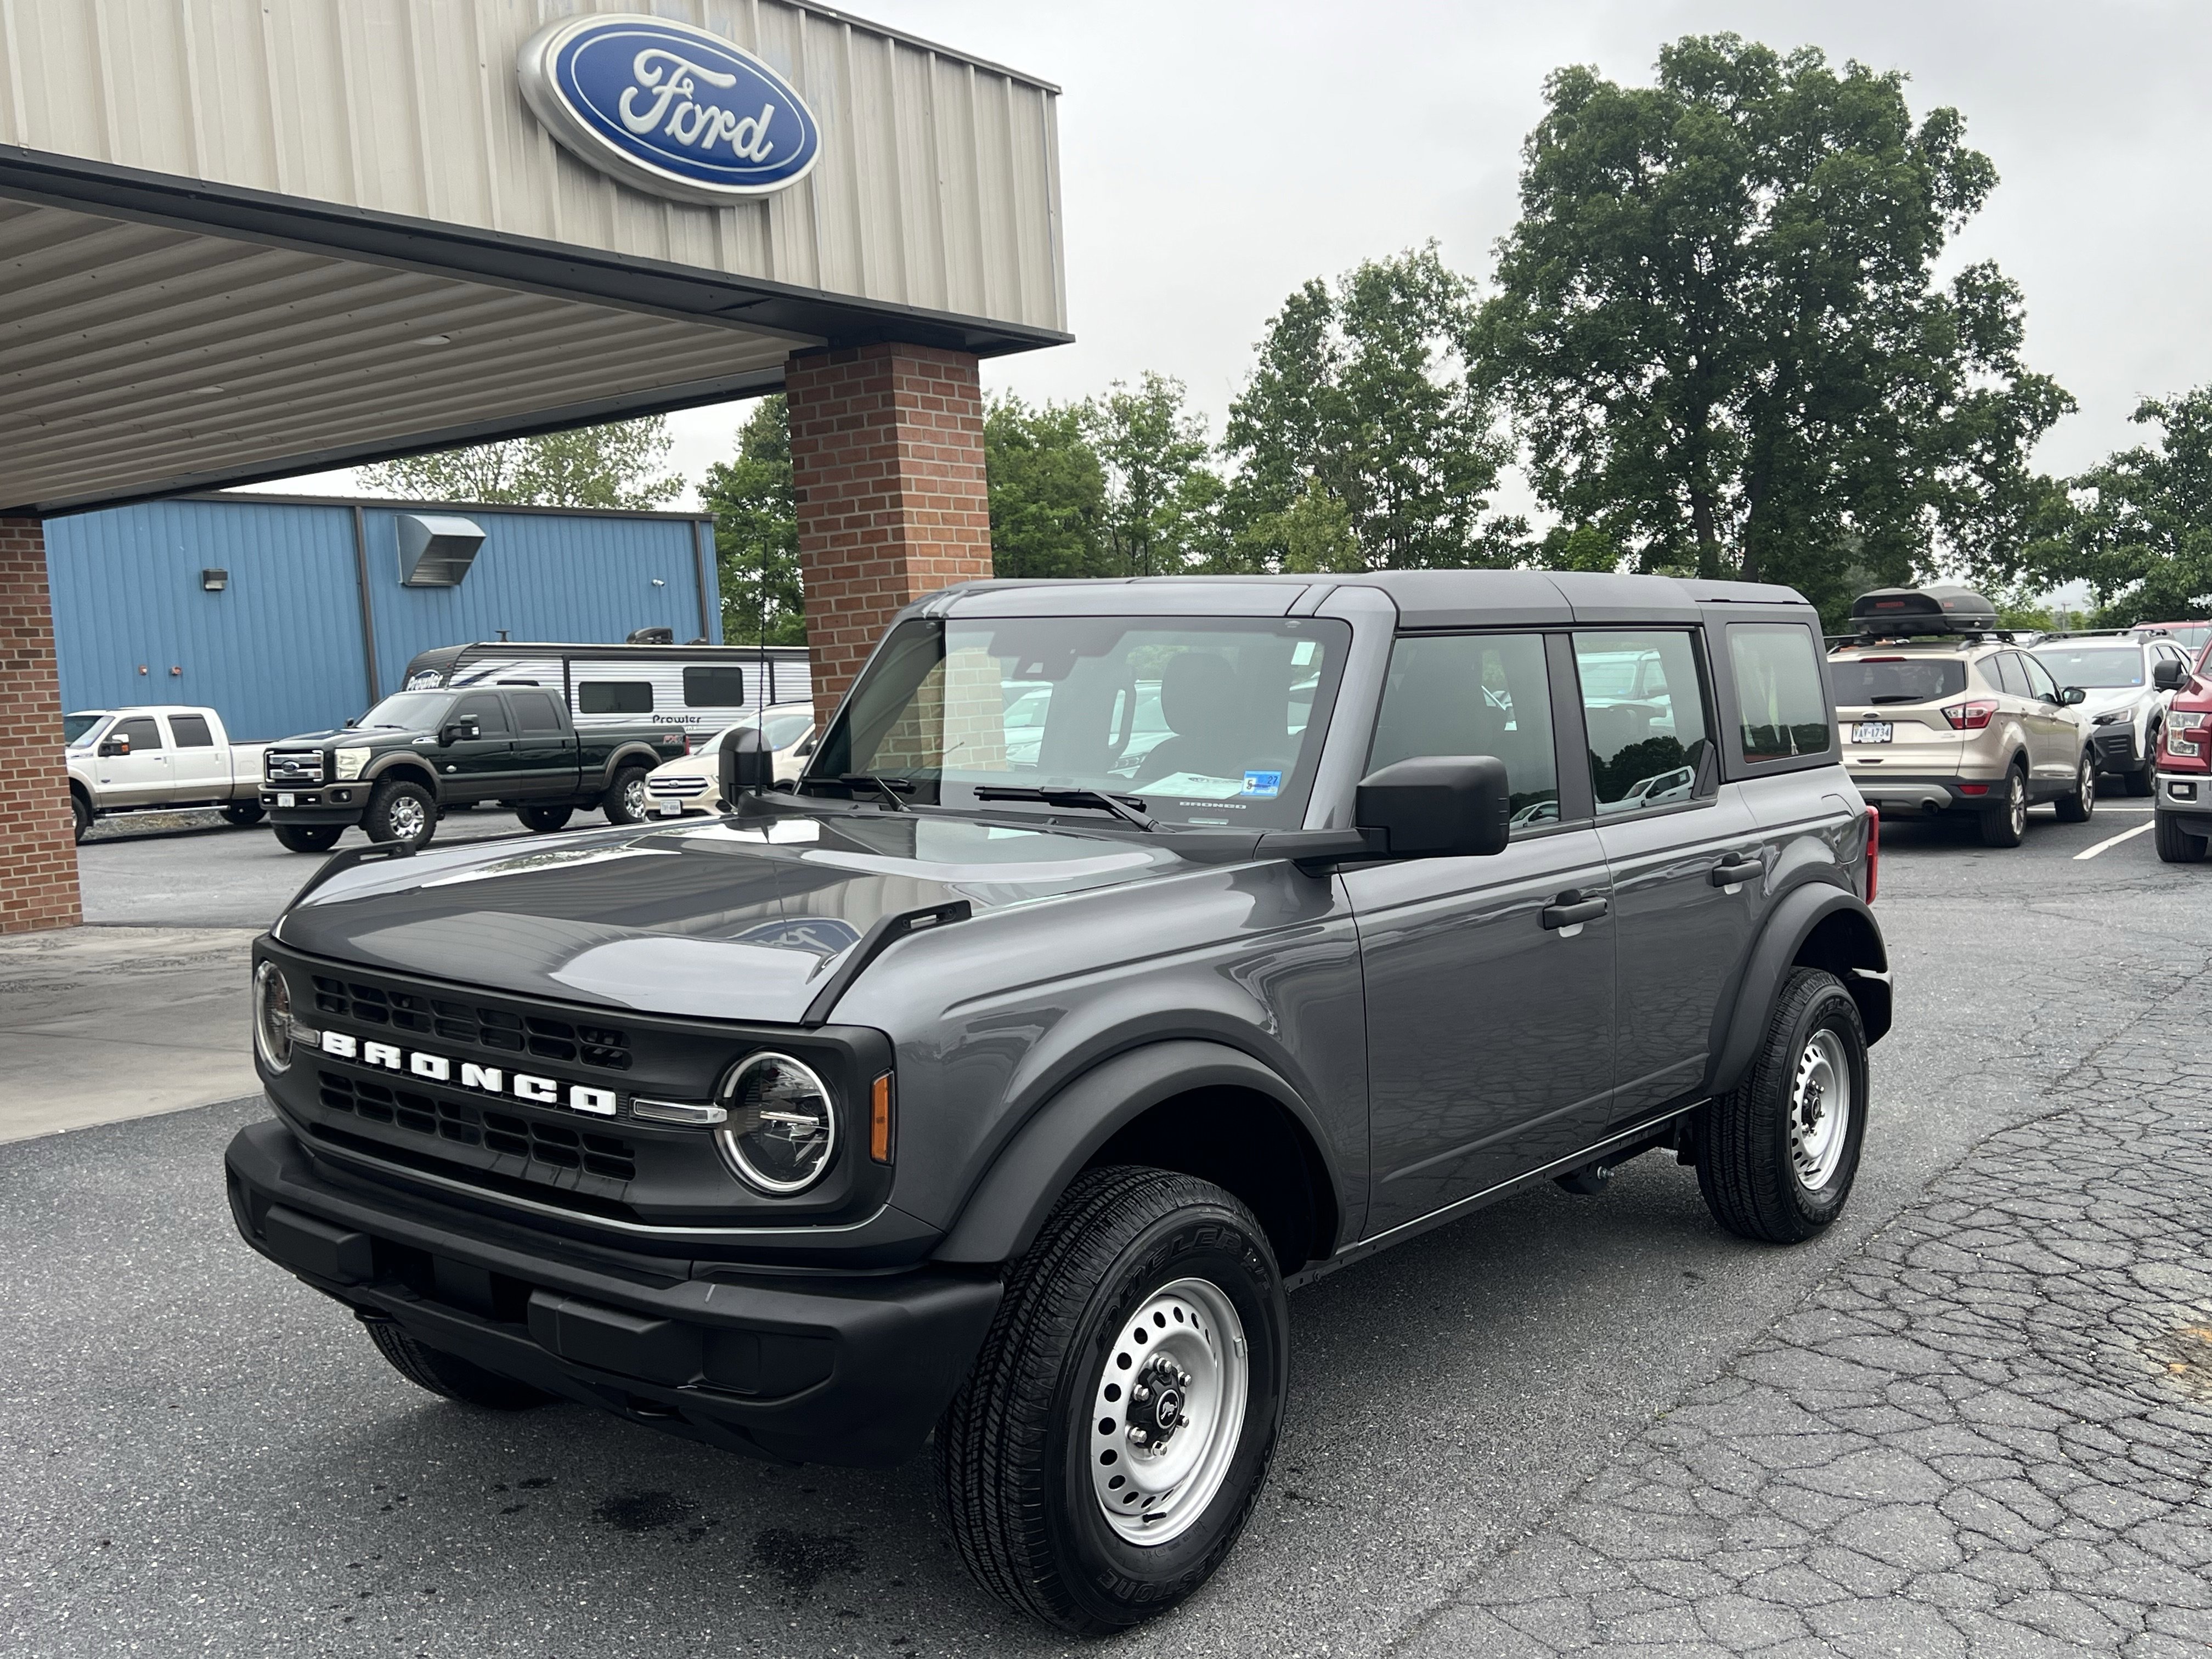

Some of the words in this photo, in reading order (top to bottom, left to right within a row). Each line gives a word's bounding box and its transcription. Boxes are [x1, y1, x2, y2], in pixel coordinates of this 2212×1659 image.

[618, 48, 775, 163] Ford
[406, 673, 444, 691] Prowler
[653, 714, 702, 723] Prowler
[1267, 775, 1278, 785] 27
[1180, 801, 1246, 810] BRONCO
[321, 1030, 618, 1116] BRONCO
